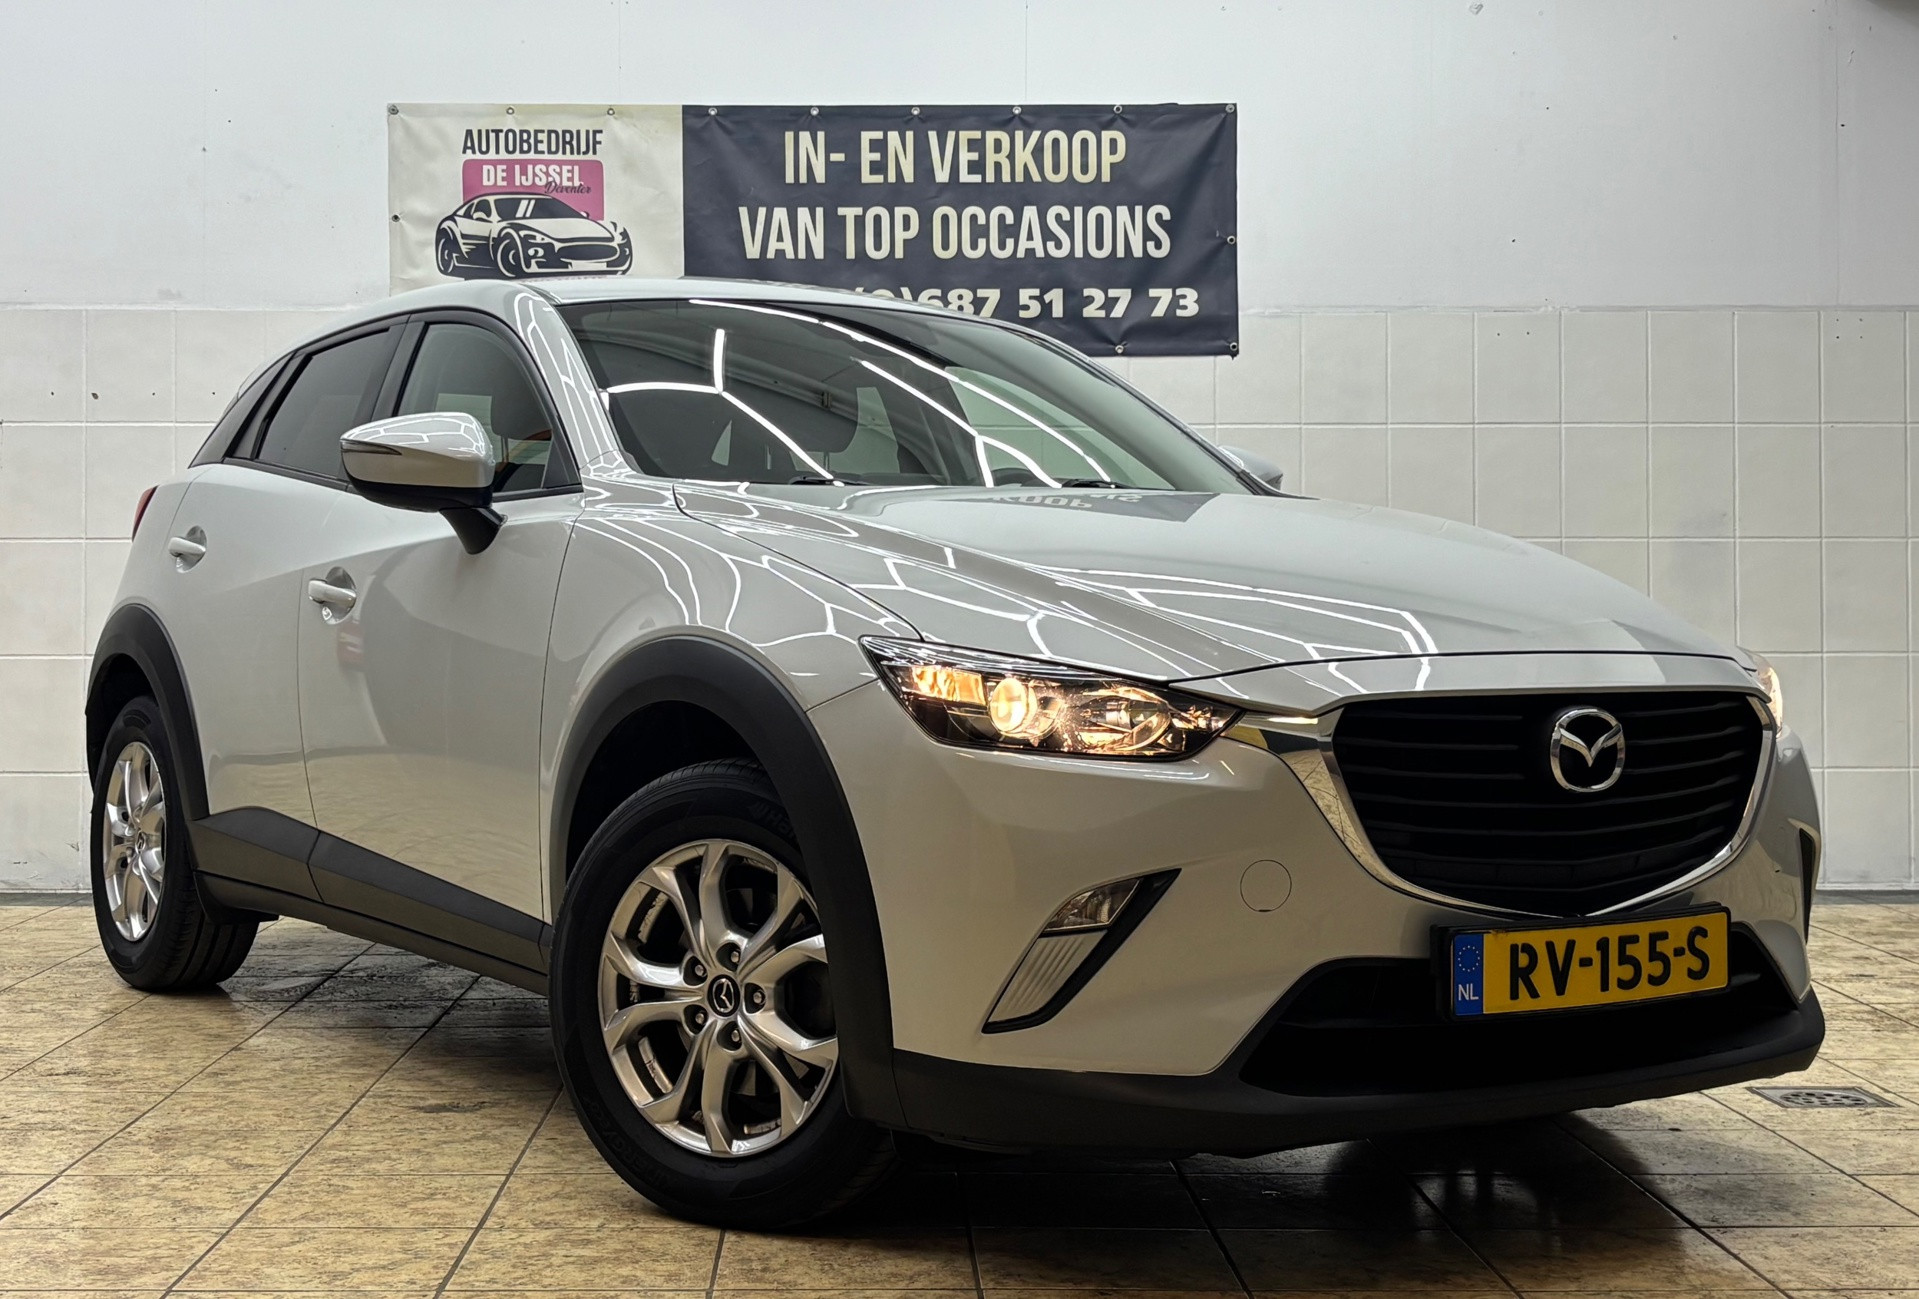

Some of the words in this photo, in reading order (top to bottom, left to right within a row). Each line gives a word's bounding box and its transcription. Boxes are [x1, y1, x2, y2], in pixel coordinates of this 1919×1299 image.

[462, 128, 603, 156] AUTOBEDRIJF
[784, 130, 845, 184] IN-
[860, 130, 915, 184] EN
[928, 129, 1127, 184] VERKOOP
[482, 164, 507, 187] DE
[515, 164, 584, 187] IJSSEL
[738, 207, 826, 260] VAN
[837, 207, 920, 260] TOP
[930, 205, 1172, 260] OCCASIONS
[1018, 288, 1064, 318] 51
[1082, 288, 1133, 318] 27
[1149, 288, 1200, 317] 73
[1509, 926, 1710, 1000] RV-155-S
[1458, 983, 1479, 1001] NL
